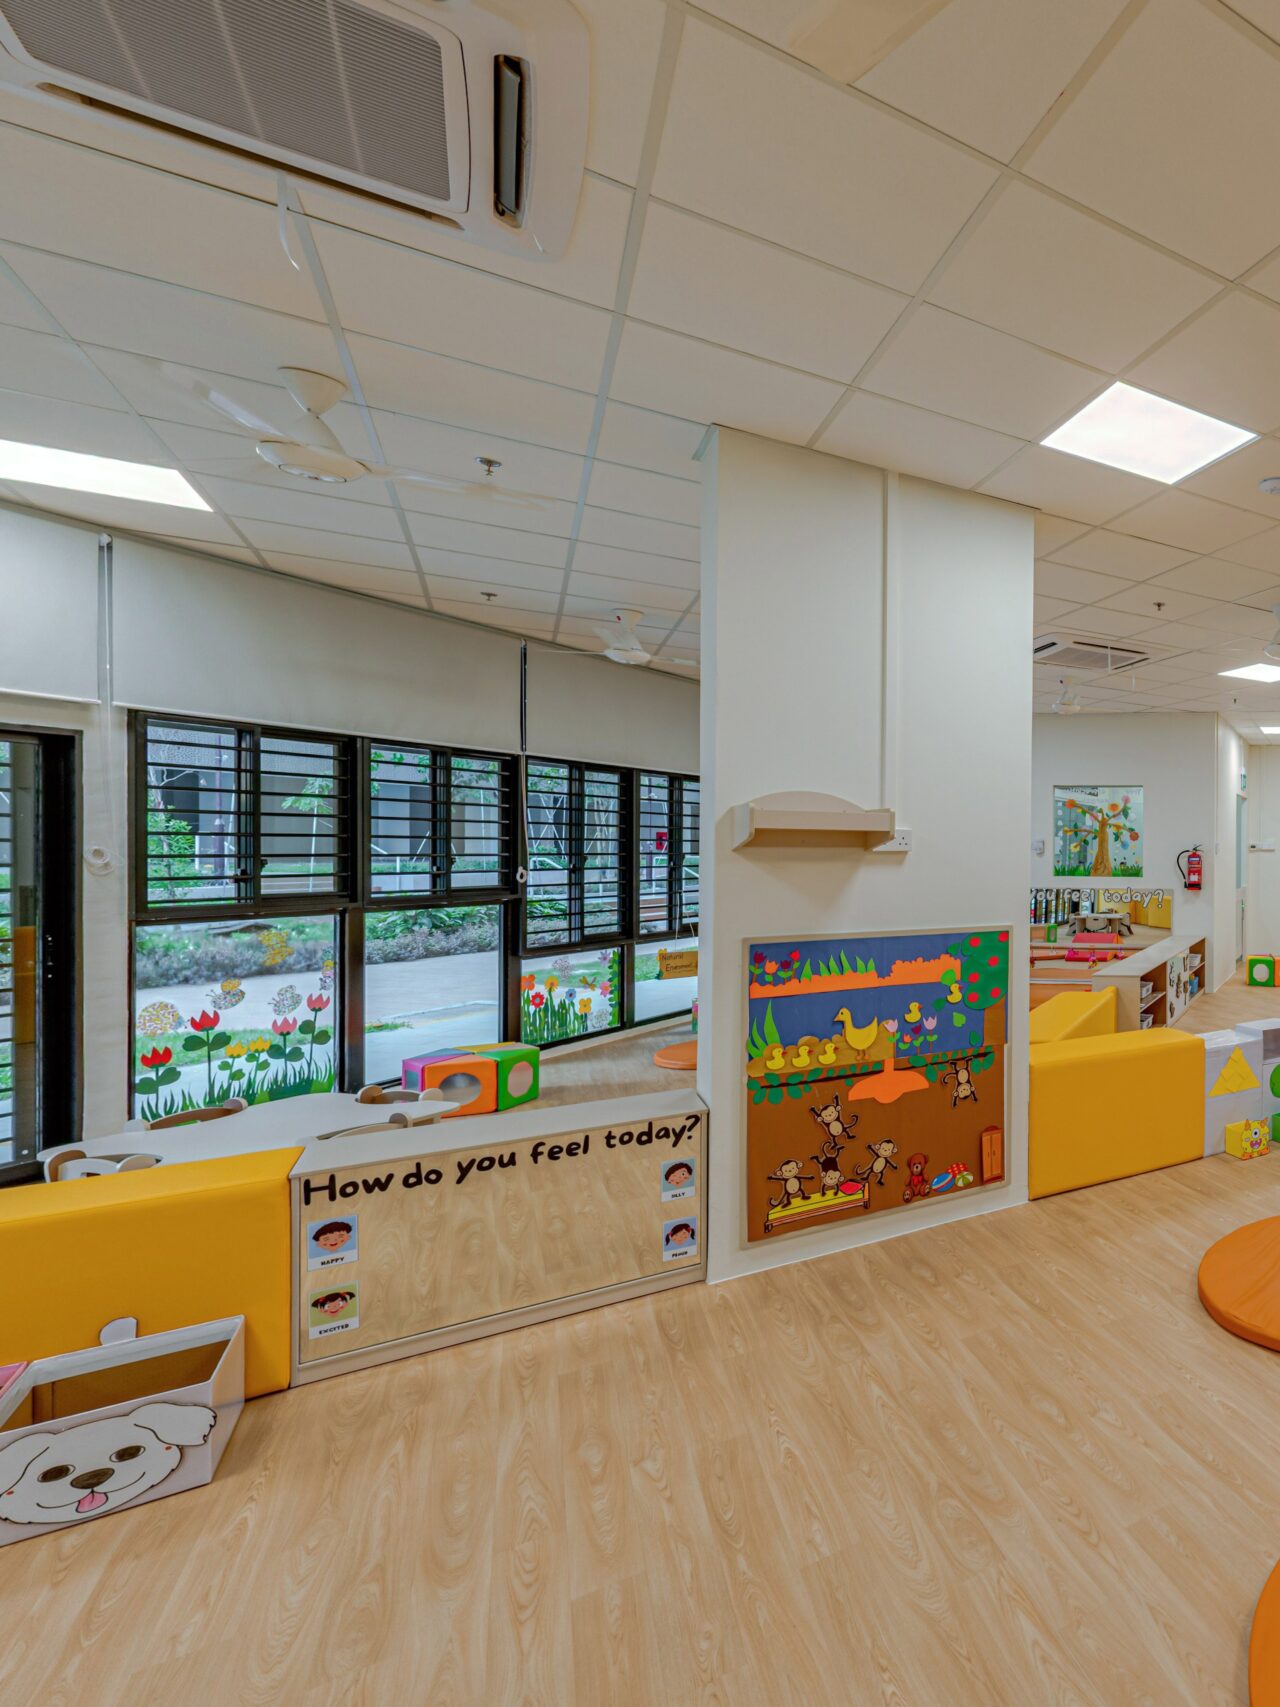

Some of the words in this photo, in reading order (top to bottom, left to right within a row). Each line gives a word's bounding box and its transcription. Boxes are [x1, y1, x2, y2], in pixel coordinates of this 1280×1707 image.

[1063, 887, 1095, 903] feel
[1103, 886, 1165, 909] today?
[303, 1163, 394, 1206] How
[402, 1161, 443, 1189] do
[455, 1151, 517, 1185] you
[530, 1134, 590, 1164] feel
[604, 1114, 701, 1148] today?
[320, 1256, 345, 1266] HAPPY
[319, 1322, 350, 1335] EXCITED
